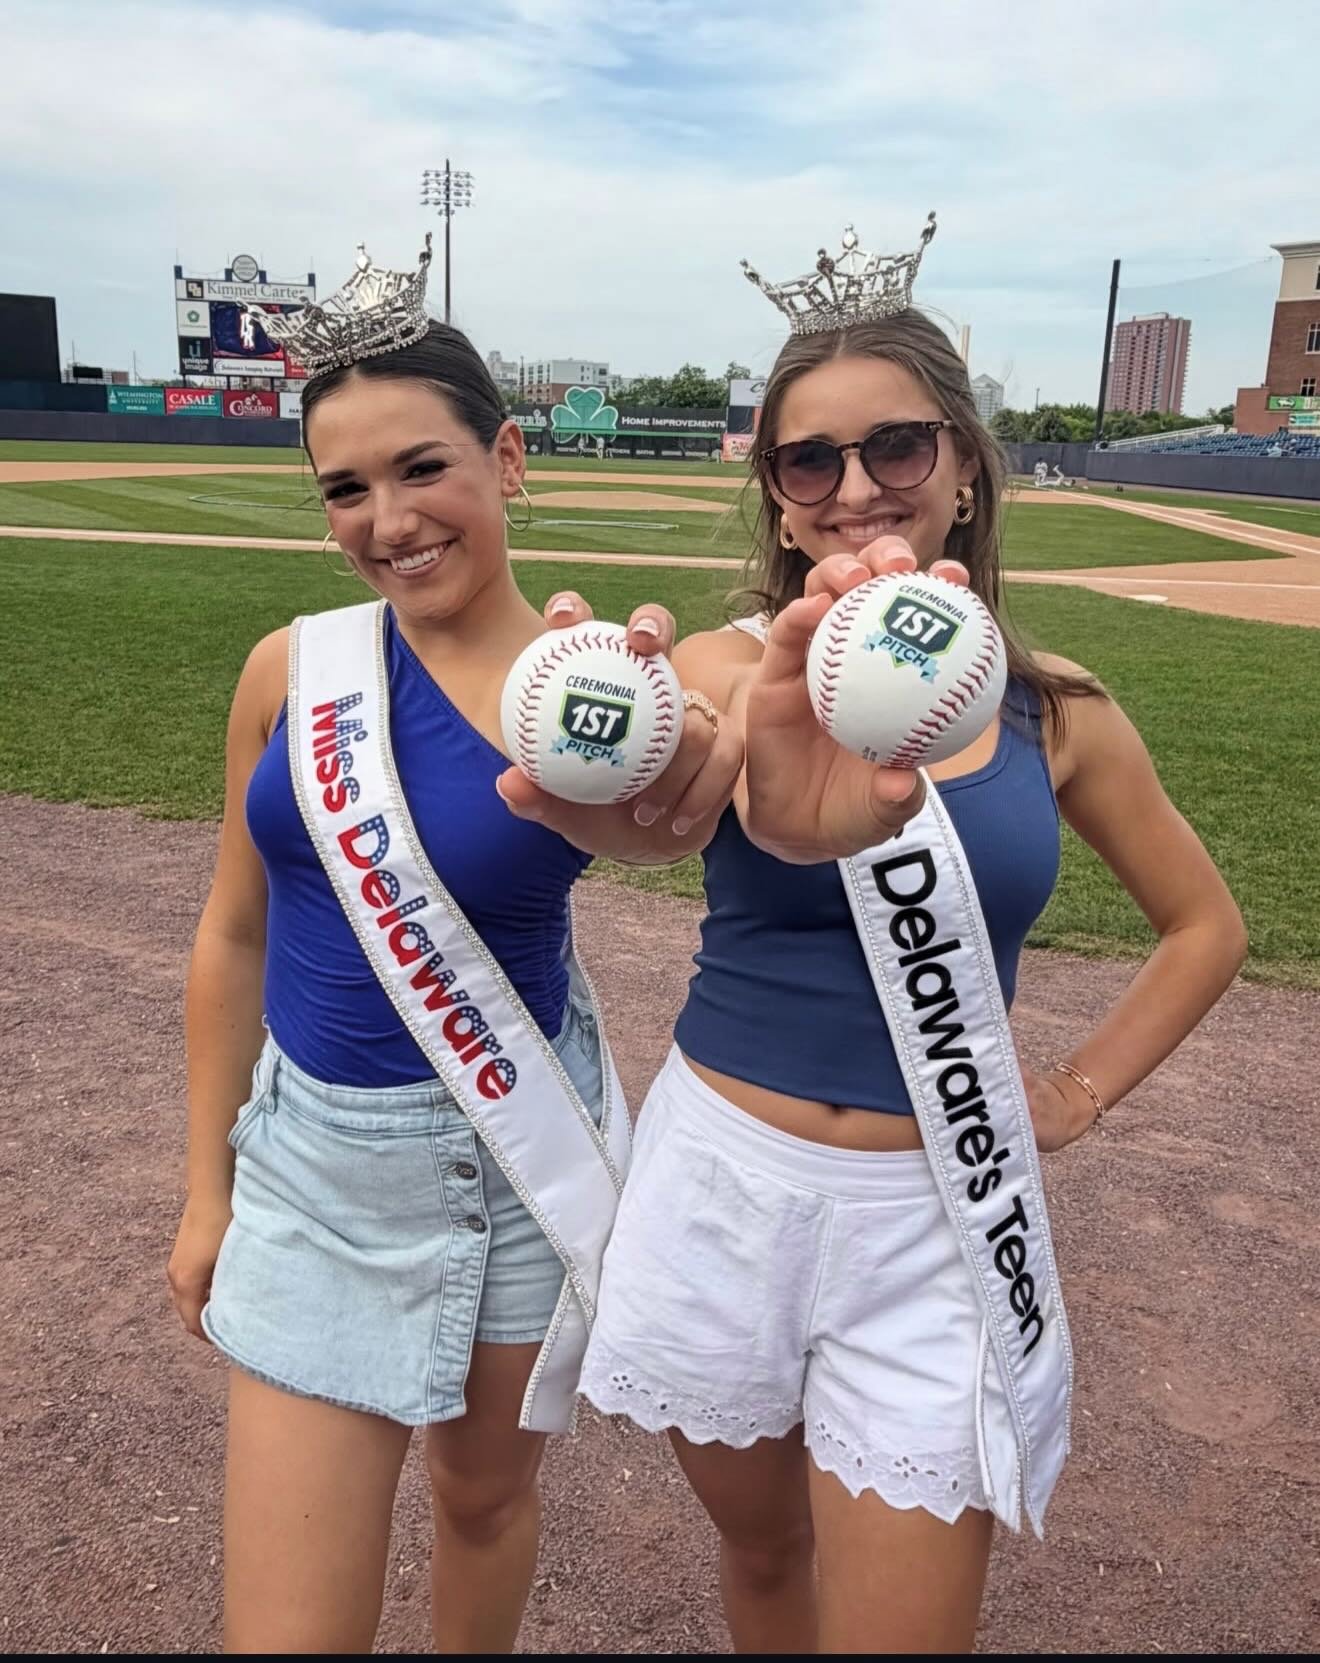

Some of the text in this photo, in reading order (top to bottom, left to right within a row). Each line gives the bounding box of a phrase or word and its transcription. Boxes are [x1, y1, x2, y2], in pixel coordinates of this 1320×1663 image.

[208, 282, 257, 296] Kimmel
[260, 285, 304, 298] Carter
[168, 393, 216, 406] CASALE
[229, 400, 273, 416] CONCORD
[621, 416, 726, 428] HOME IMPROVEMENTS
[898, 584, 968, 623] CEREMONIAL
[890, 605, 949, 645] 1ST
[878, 635, 929, 668] PITCH
[565, 675, 636, 701] CEREMONIAL
[570, 703, 623, 739] 1ST
[565, 739, 614, 759] PITCH
[312, 691, 517, 1100] Miss Delaware
[871, 847, 1044, 1357] Delaware's Teen
